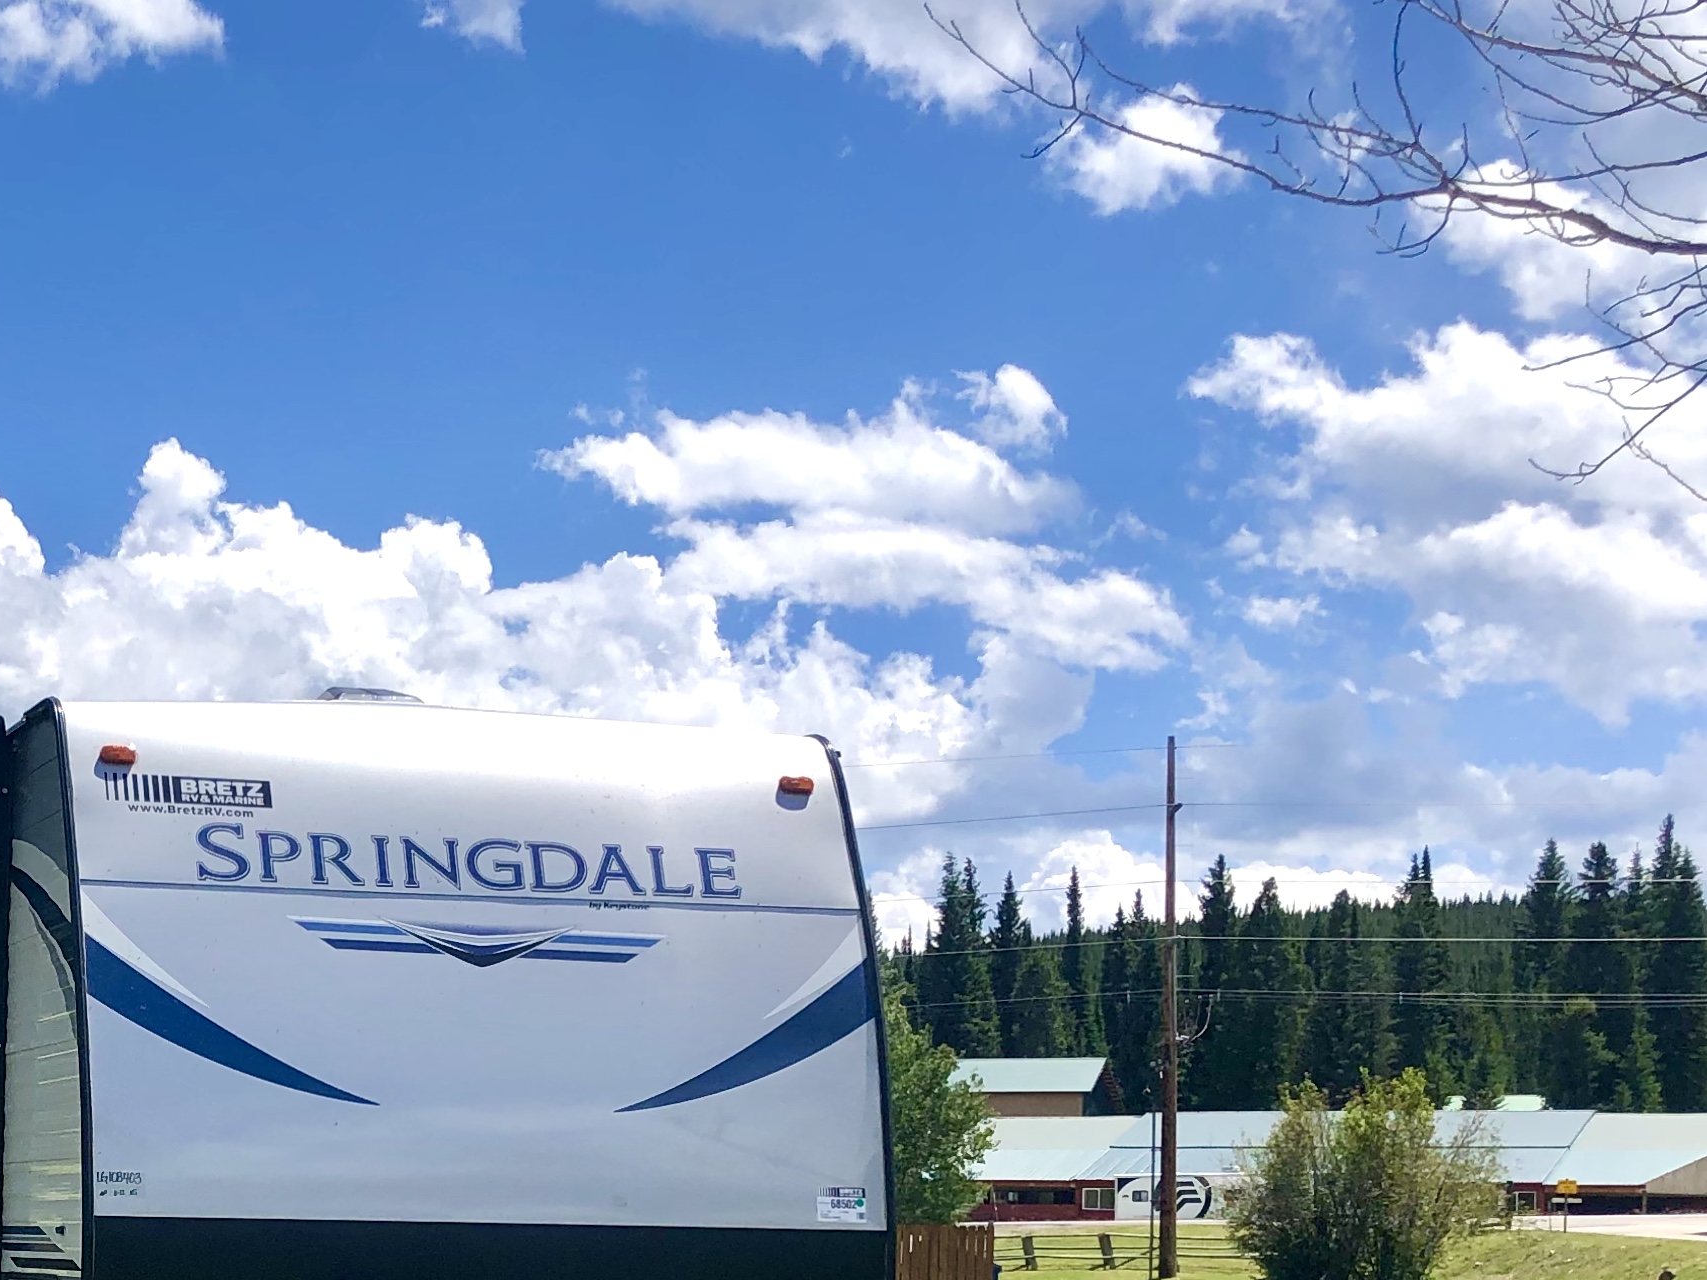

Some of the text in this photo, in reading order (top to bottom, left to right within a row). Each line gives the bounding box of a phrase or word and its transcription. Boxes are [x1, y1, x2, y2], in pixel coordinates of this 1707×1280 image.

[180, 779, 264, 797] BRETZ
[128, 804, 254, 818] www.BretzRV.com
[195, 822, 742, 899] SPRINGDALE
